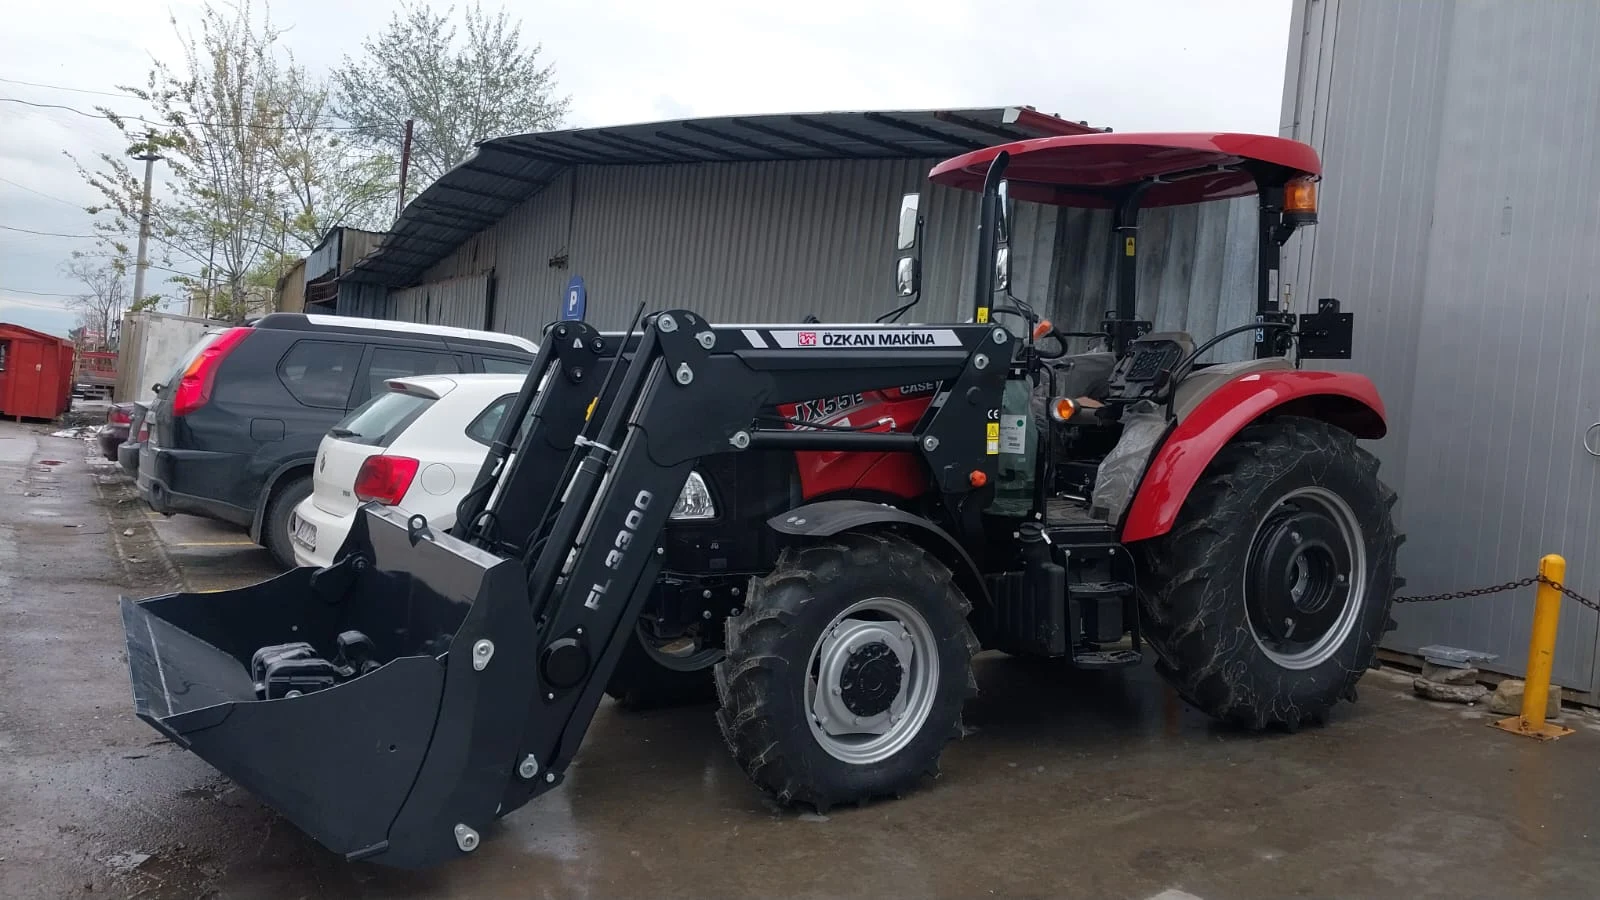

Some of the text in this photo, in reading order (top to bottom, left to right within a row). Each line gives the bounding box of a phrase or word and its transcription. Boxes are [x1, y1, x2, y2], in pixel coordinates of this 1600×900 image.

[569, 291, 578, 312] P
[822, 332, 875, 346] ÖZKAN
[878, 331, 936, 345] MAKİNA
[900, 382, 934, 394] CASE
[791, 392, 865, 422] JX55E
[987, 409, 999, 419] CE
[584, 489, 653, 610] FL 3300
